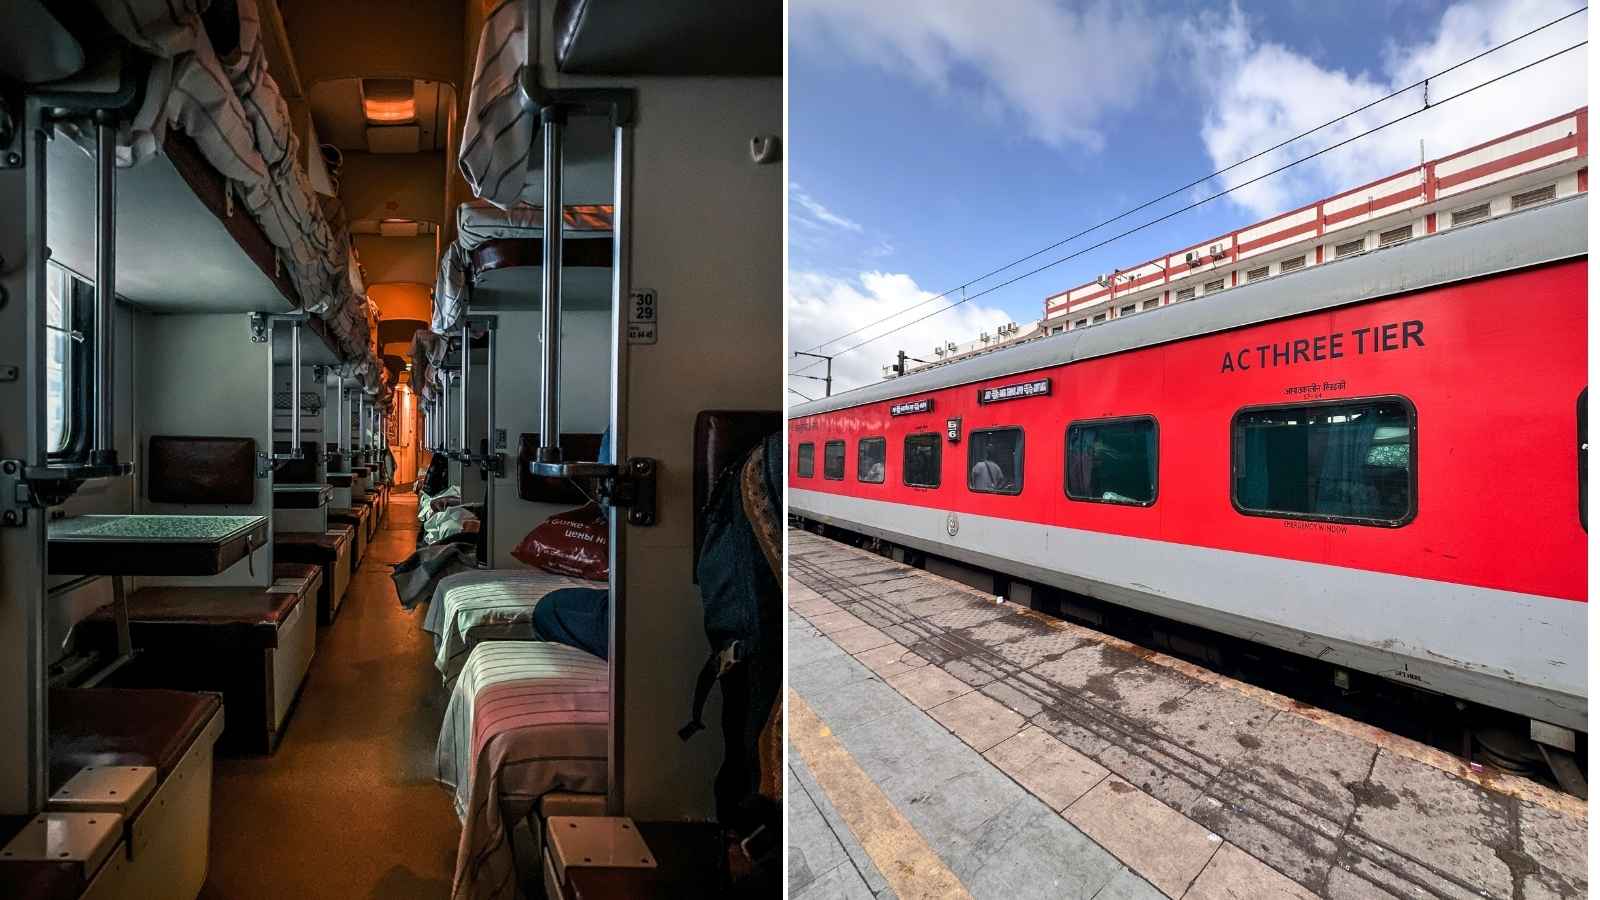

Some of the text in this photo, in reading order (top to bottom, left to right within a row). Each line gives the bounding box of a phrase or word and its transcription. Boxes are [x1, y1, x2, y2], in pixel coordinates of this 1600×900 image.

[636, 293, 653, 306] 30
[636, 307, 653, 319] 29
[1220, 319, 1425, 374] AC THREE TIER
